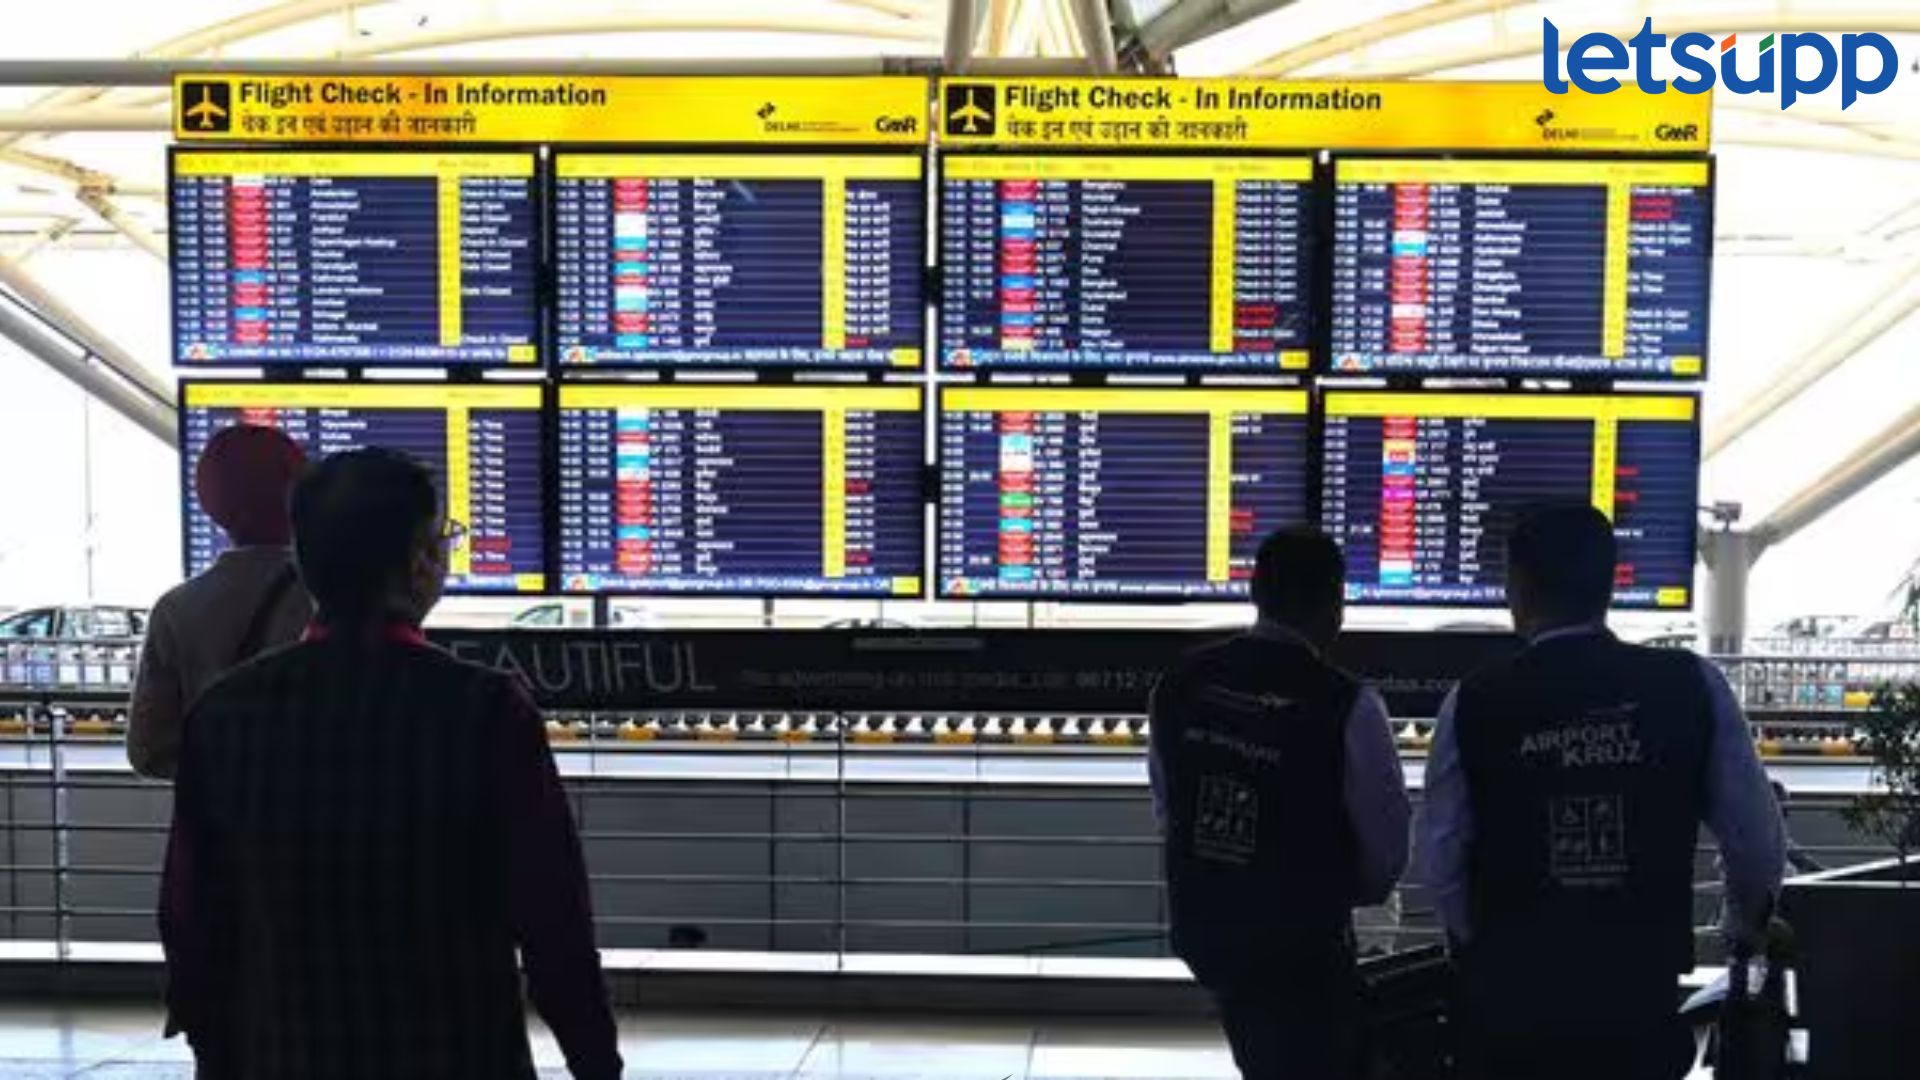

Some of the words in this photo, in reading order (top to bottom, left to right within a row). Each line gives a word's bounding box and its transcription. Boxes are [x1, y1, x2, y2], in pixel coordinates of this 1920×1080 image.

[240, 82, 313, 108] Flight
[320, 81, 402, 104] Check
[424, 82, 448, 105] In
[457, 82, 606, 105] Information
[1005, 86, 1079, 112] Flight
[1088, 86, 1170, 109] Check
[1196, 87, 1219, 109] In
[1229, 87, 1381, 110] Information
[1520, 722, 1631, 756] AIRPORT
